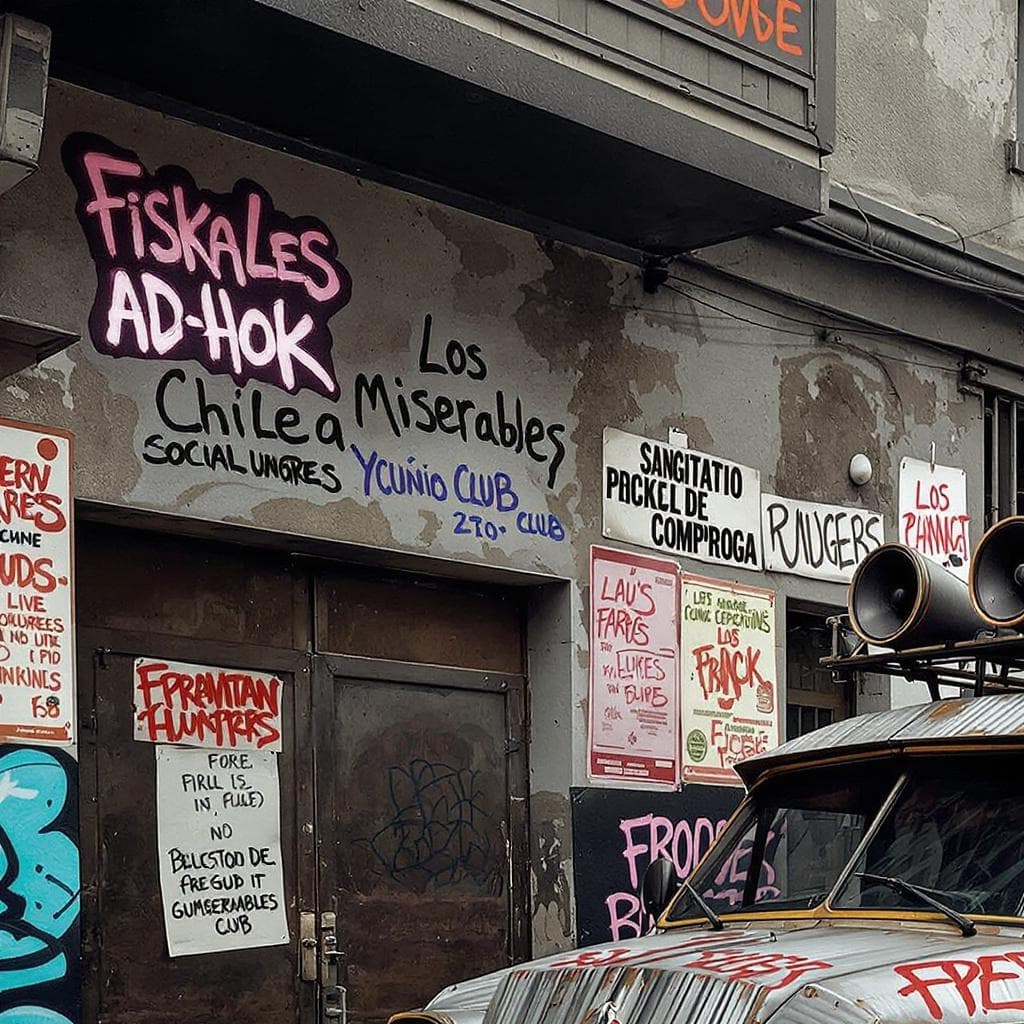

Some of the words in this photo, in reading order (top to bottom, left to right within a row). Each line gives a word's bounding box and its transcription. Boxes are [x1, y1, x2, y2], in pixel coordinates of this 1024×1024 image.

[106, 269, 338, 392] AD-HOK
[418, 314, 488, 381] Los
[354, 372, 566, 488] Miserables
[142, 434, 248, 475] SOCIAL
[640, 442, 743, 499] SANGITATIO
[454, 464, 519, 512] CLUB
[684, 490, 709, 521] DE
[915, 480, 950, 511] LOS
[516, 511, 565, 541] CLUB
[210, 823, 233, 840] NO
[251, 873, 267, 889] IT
